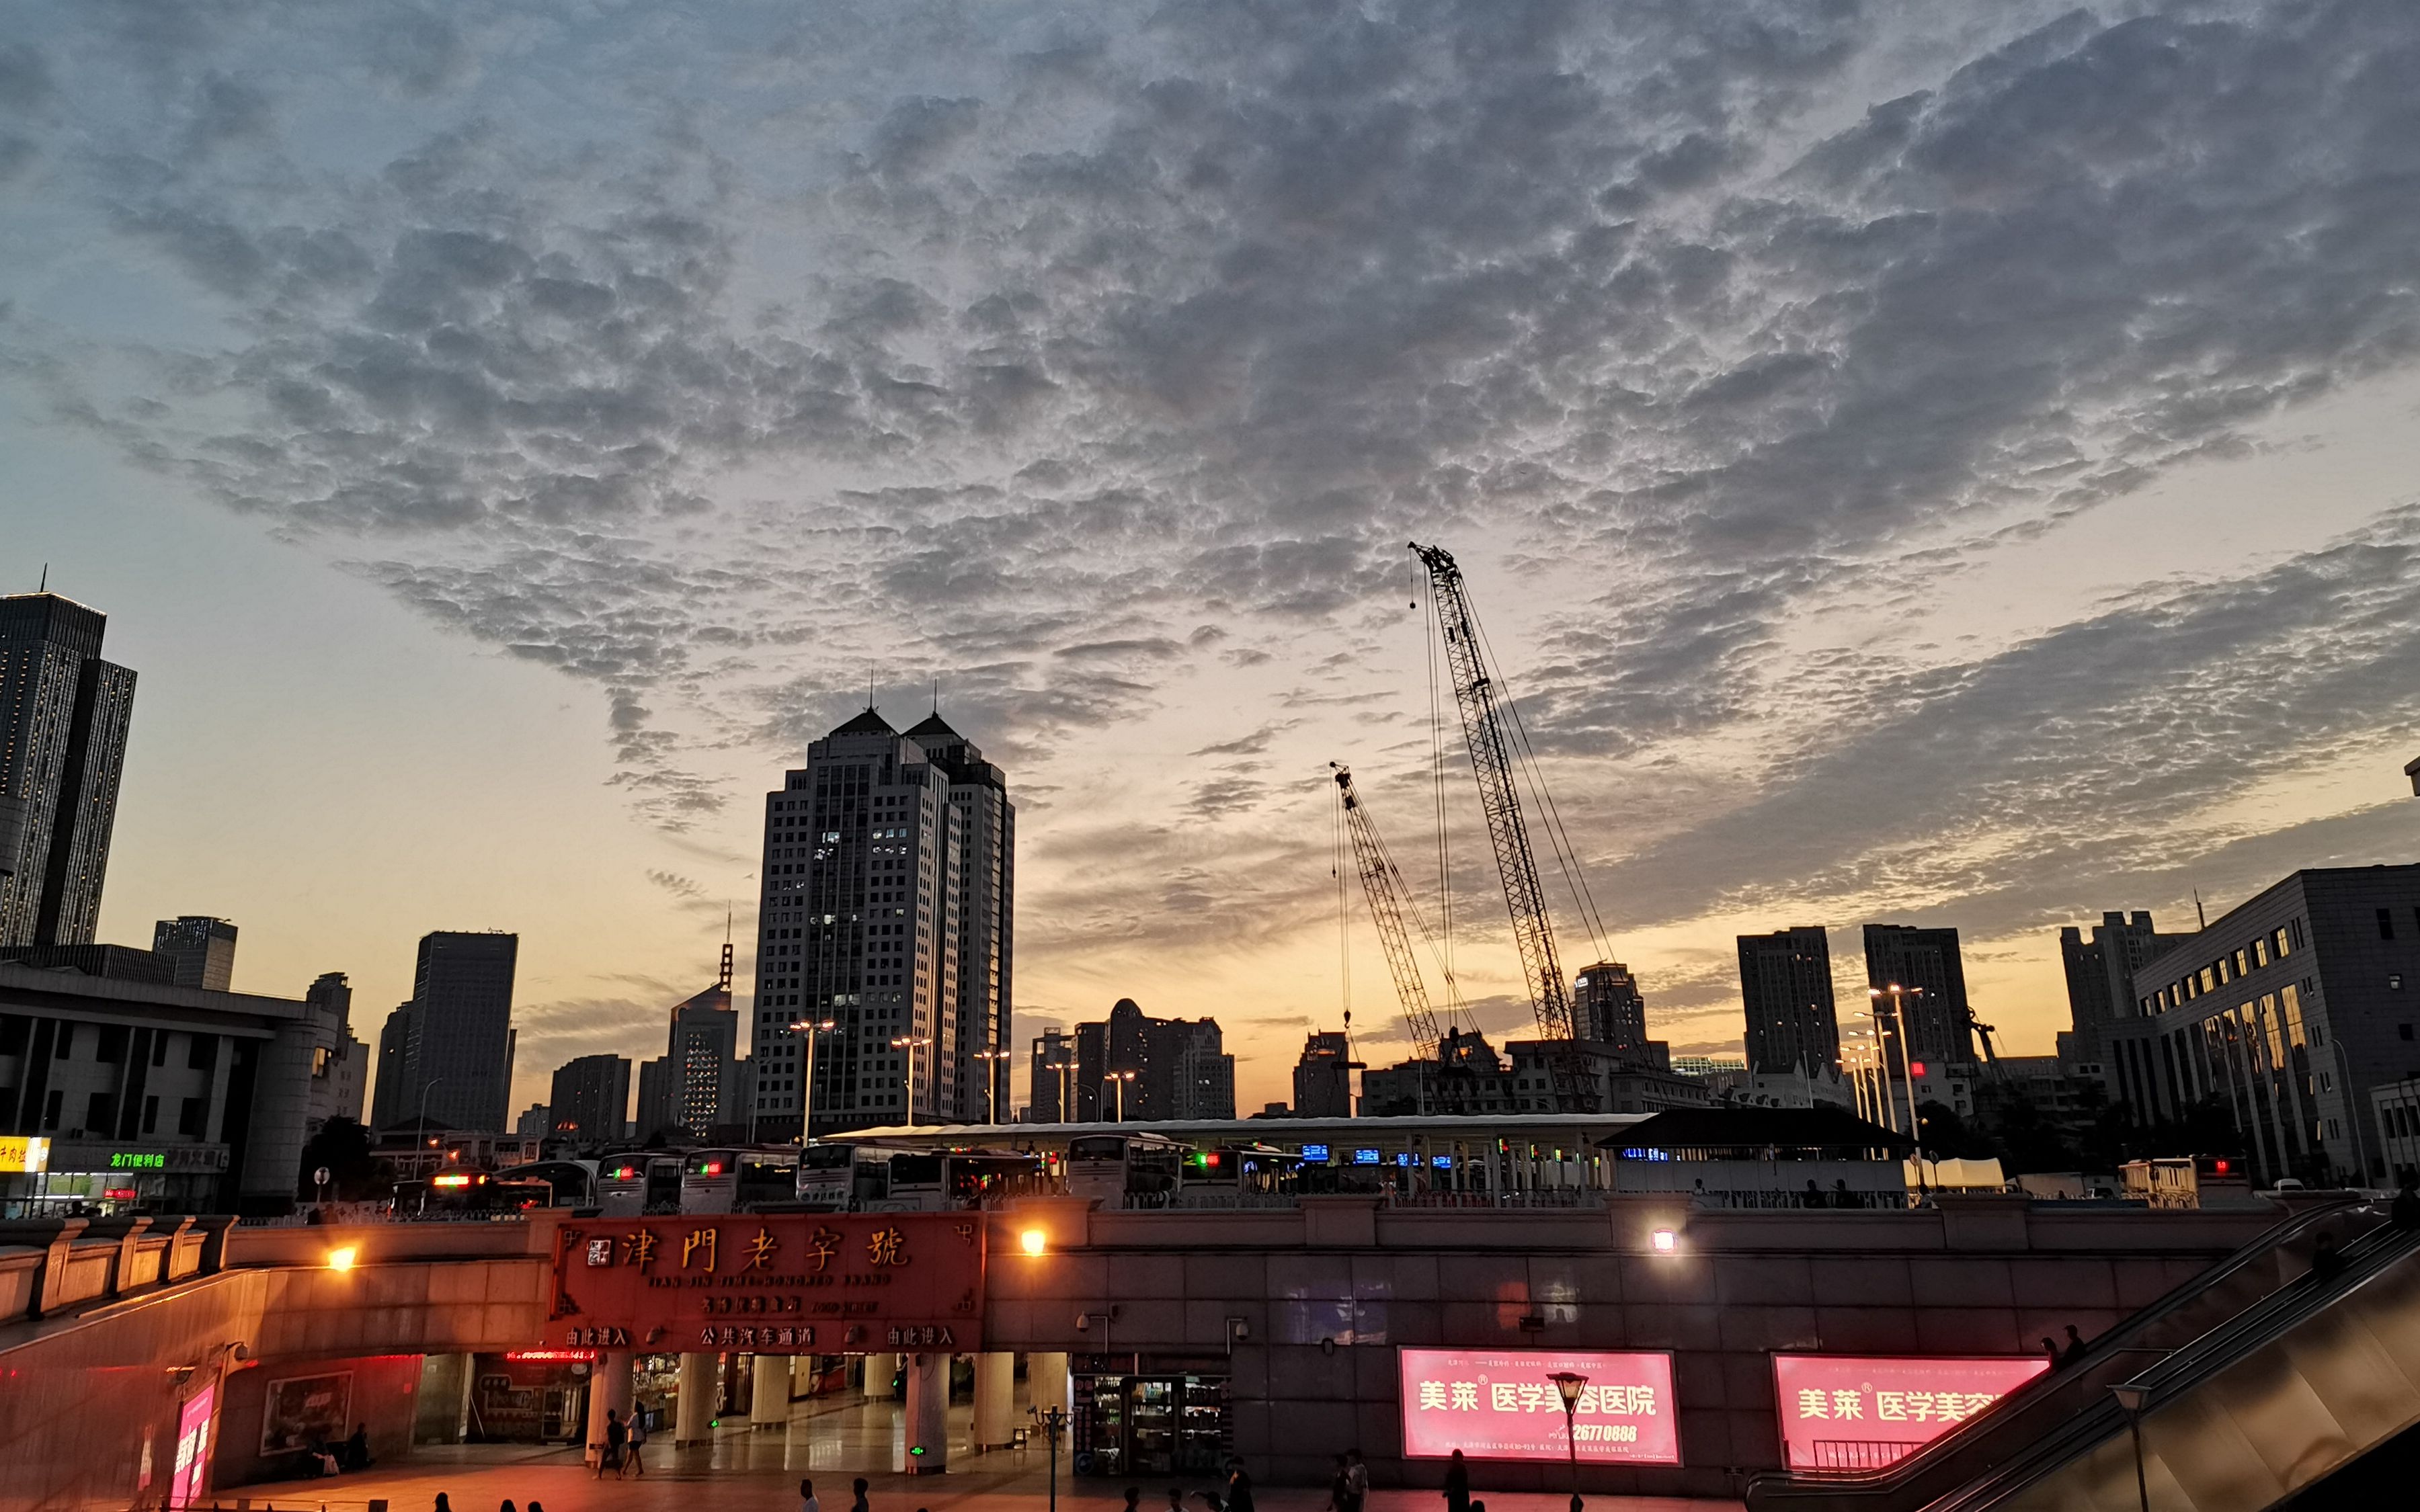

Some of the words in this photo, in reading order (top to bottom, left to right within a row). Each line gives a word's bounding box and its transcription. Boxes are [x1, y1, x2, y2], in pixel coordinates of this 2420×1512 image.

[110, 1152, 164, 1167] 龙门便利店
[622, 1227, 909, 1273] 津門老字號
[566, 1327, 627, 1346] 由此进入
[700, 1327, 814, 1346] 公共汽车通道
[887, 1327, 953, 1345] 由此进入
